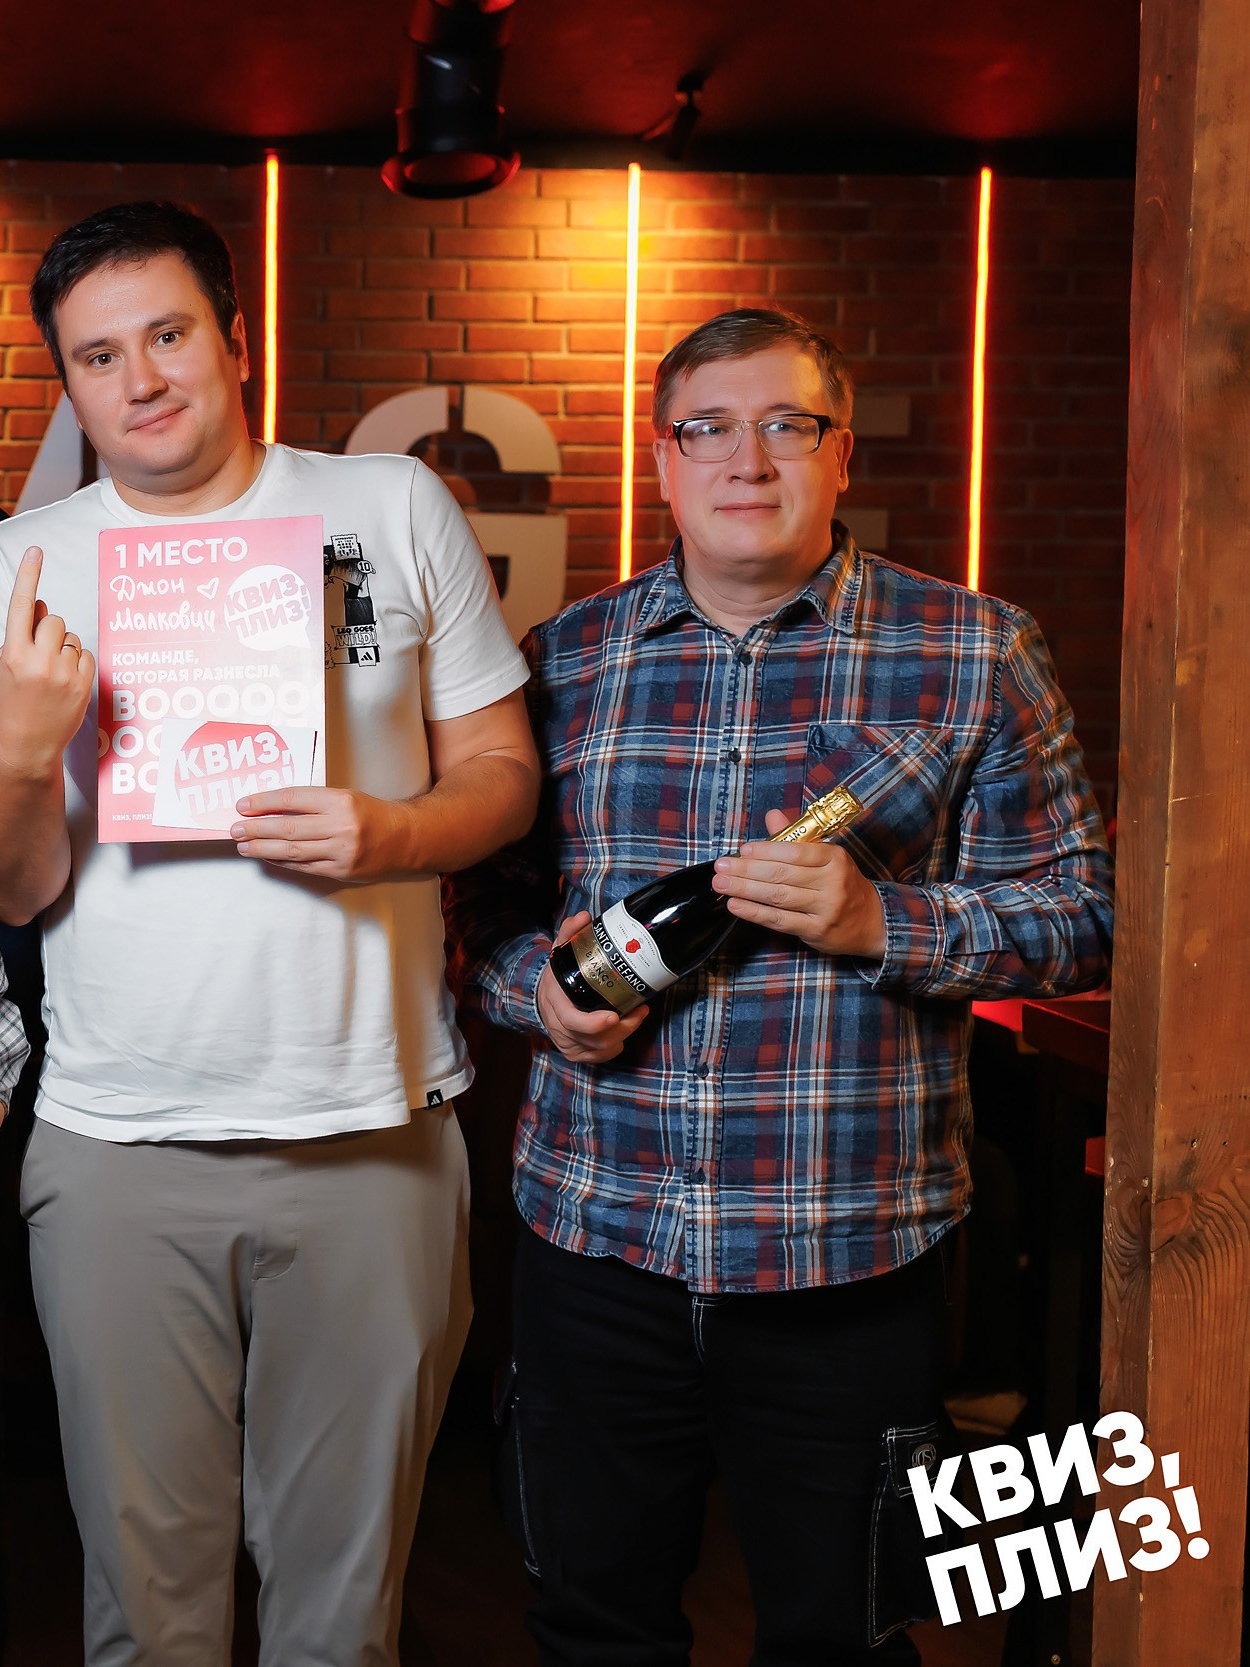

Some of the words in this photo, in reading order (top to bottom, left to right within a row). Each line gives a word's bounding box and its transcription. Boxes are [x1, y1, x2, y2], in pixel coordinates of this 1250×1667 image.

[114, 543, 127, 569] 1
[137, 536, 249, 568] МЕСТО
[358, 561, 371, 572] 10
[226, 573, 308, 617] КВИЗ,
[109, 600, 216, 633] Малкович
[227, 595, 311, 639] ПЛИЗ!
[336, 627, 352, 635] LEO
[353, 625, 375, 633] GOES
[335, 631, 378, 647] WILD!
[112, 649, 199, 667] КОМАНДЕ,
[112, 669, 190, 685] КОТОРАЯ
[193, 664, 281, 681] РАЗНЕСЛА
[177, 731, 292, 781] КВИЗ,
[585, 950, 615, 989] BIANCO
[593, 922, 614, 953] SANTO
[609, 952, 647, 993] STEFANO
